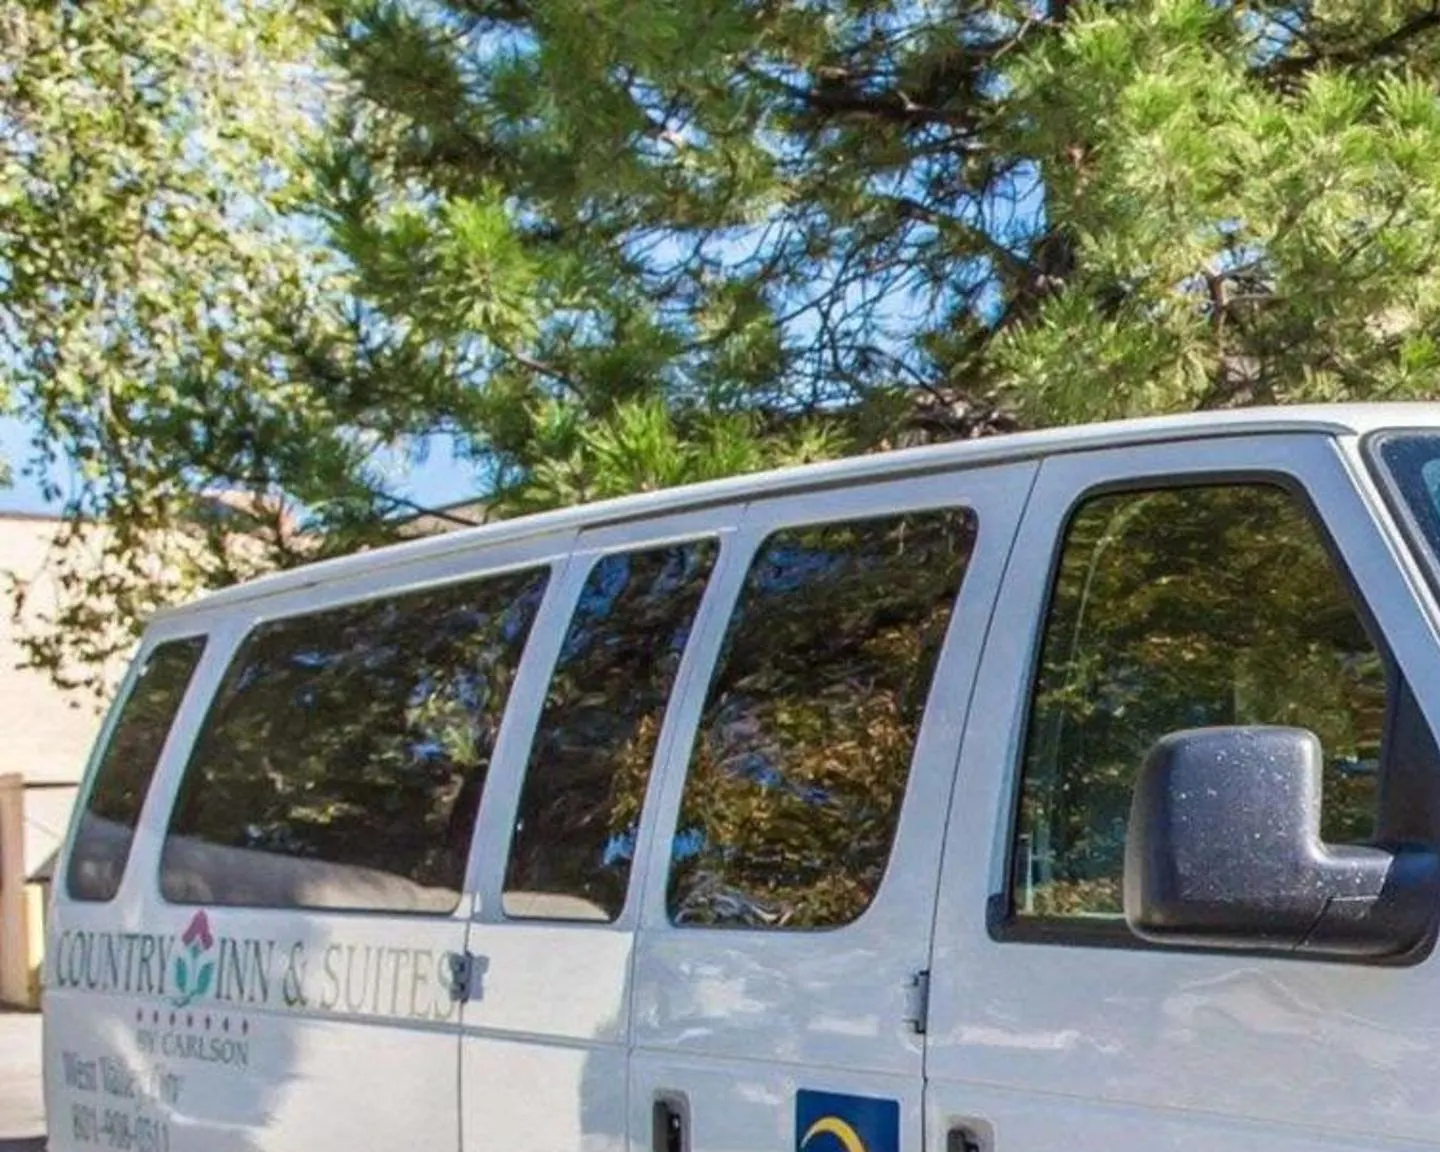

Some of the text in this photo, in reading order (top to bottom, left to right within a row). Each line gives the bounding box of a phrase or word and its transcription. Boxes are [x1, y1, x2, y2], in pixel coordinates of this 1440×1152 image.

[56, 930, 460, 1019] COUNTRY INN & SUITES
[161, 1031, 248, 1066] CARLSON
